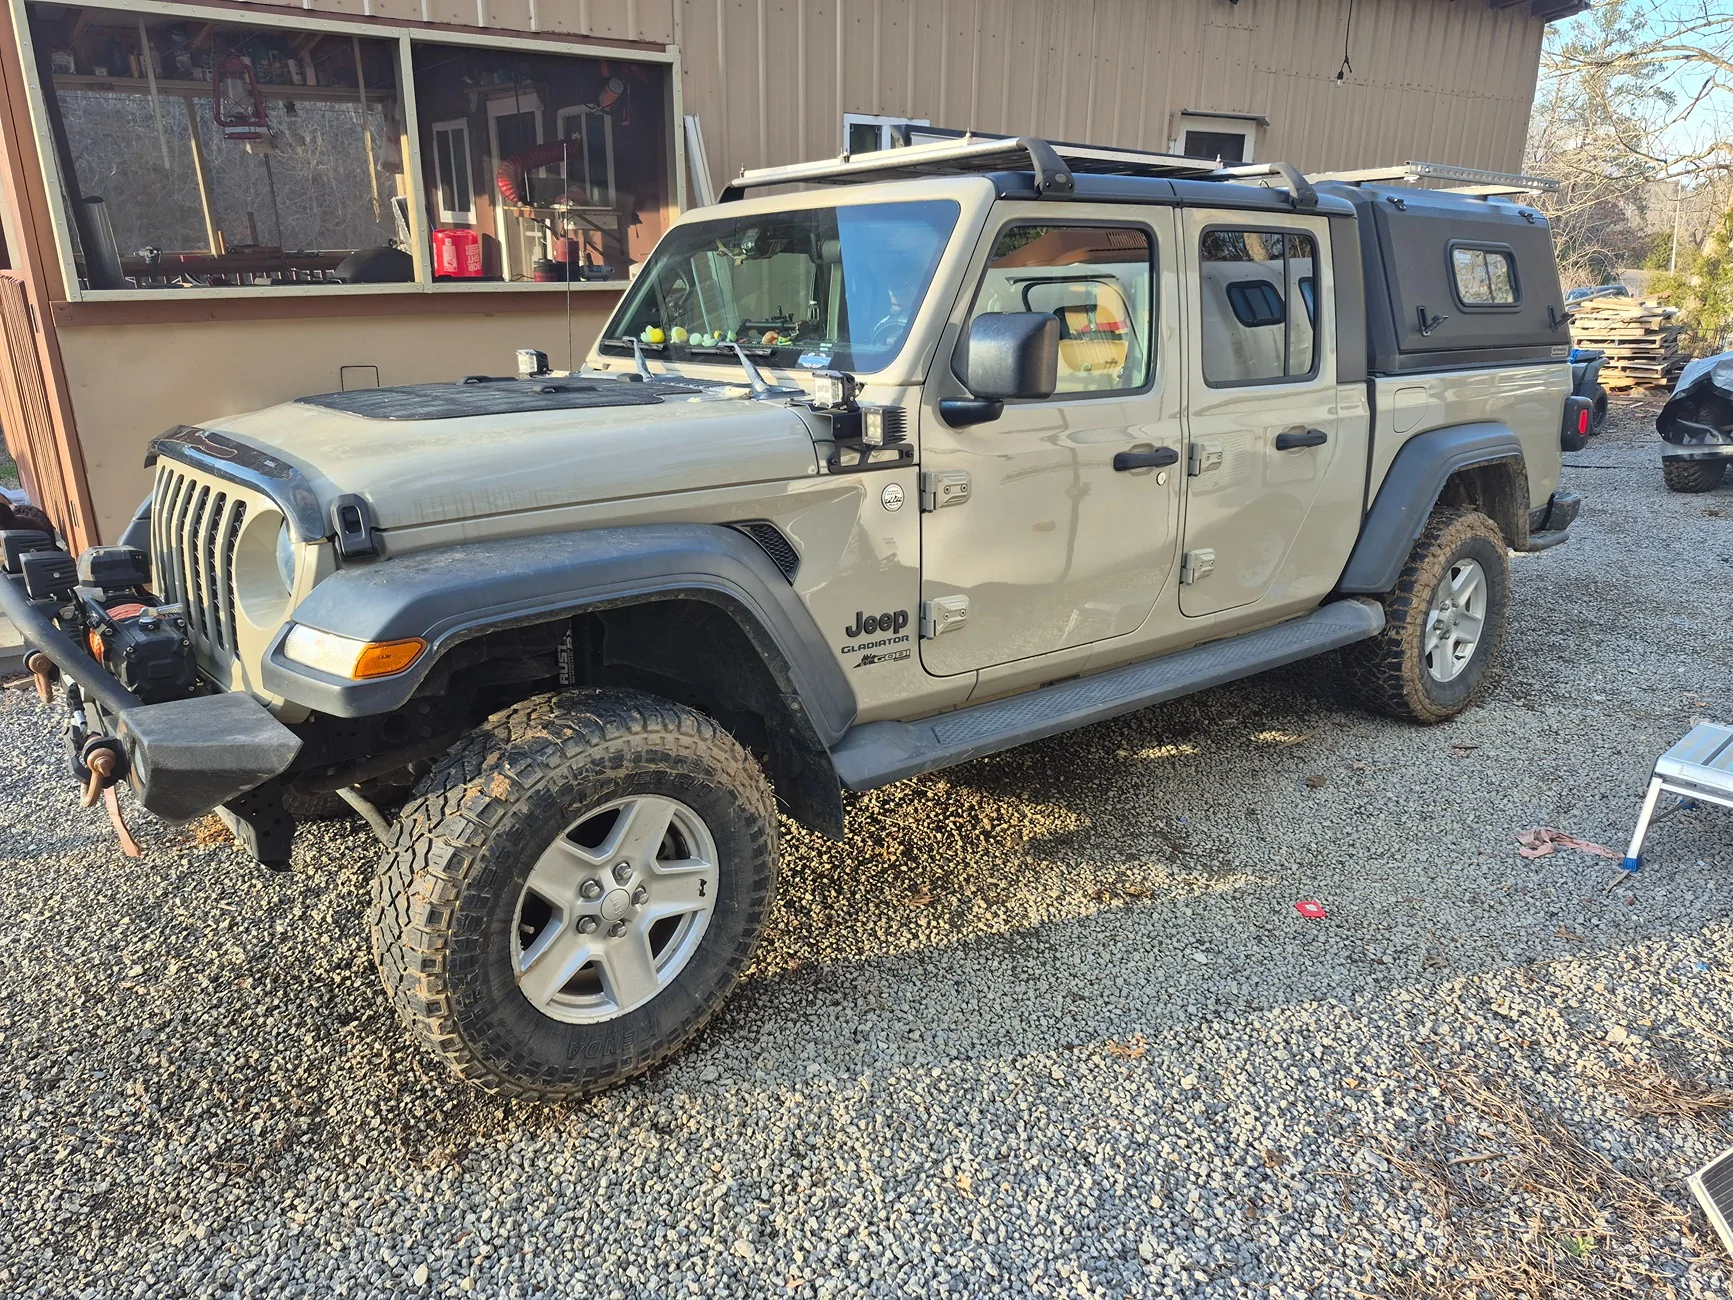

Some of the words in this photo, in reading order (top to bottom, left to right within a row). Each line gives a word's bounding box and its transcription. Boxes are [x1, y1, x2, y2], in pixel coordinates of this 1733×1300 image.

[845, 609, 909, 638] Jeep
[841, 635, 910, 654] GLADIATOR
[566, 1017, 659, 1060] KENDA
